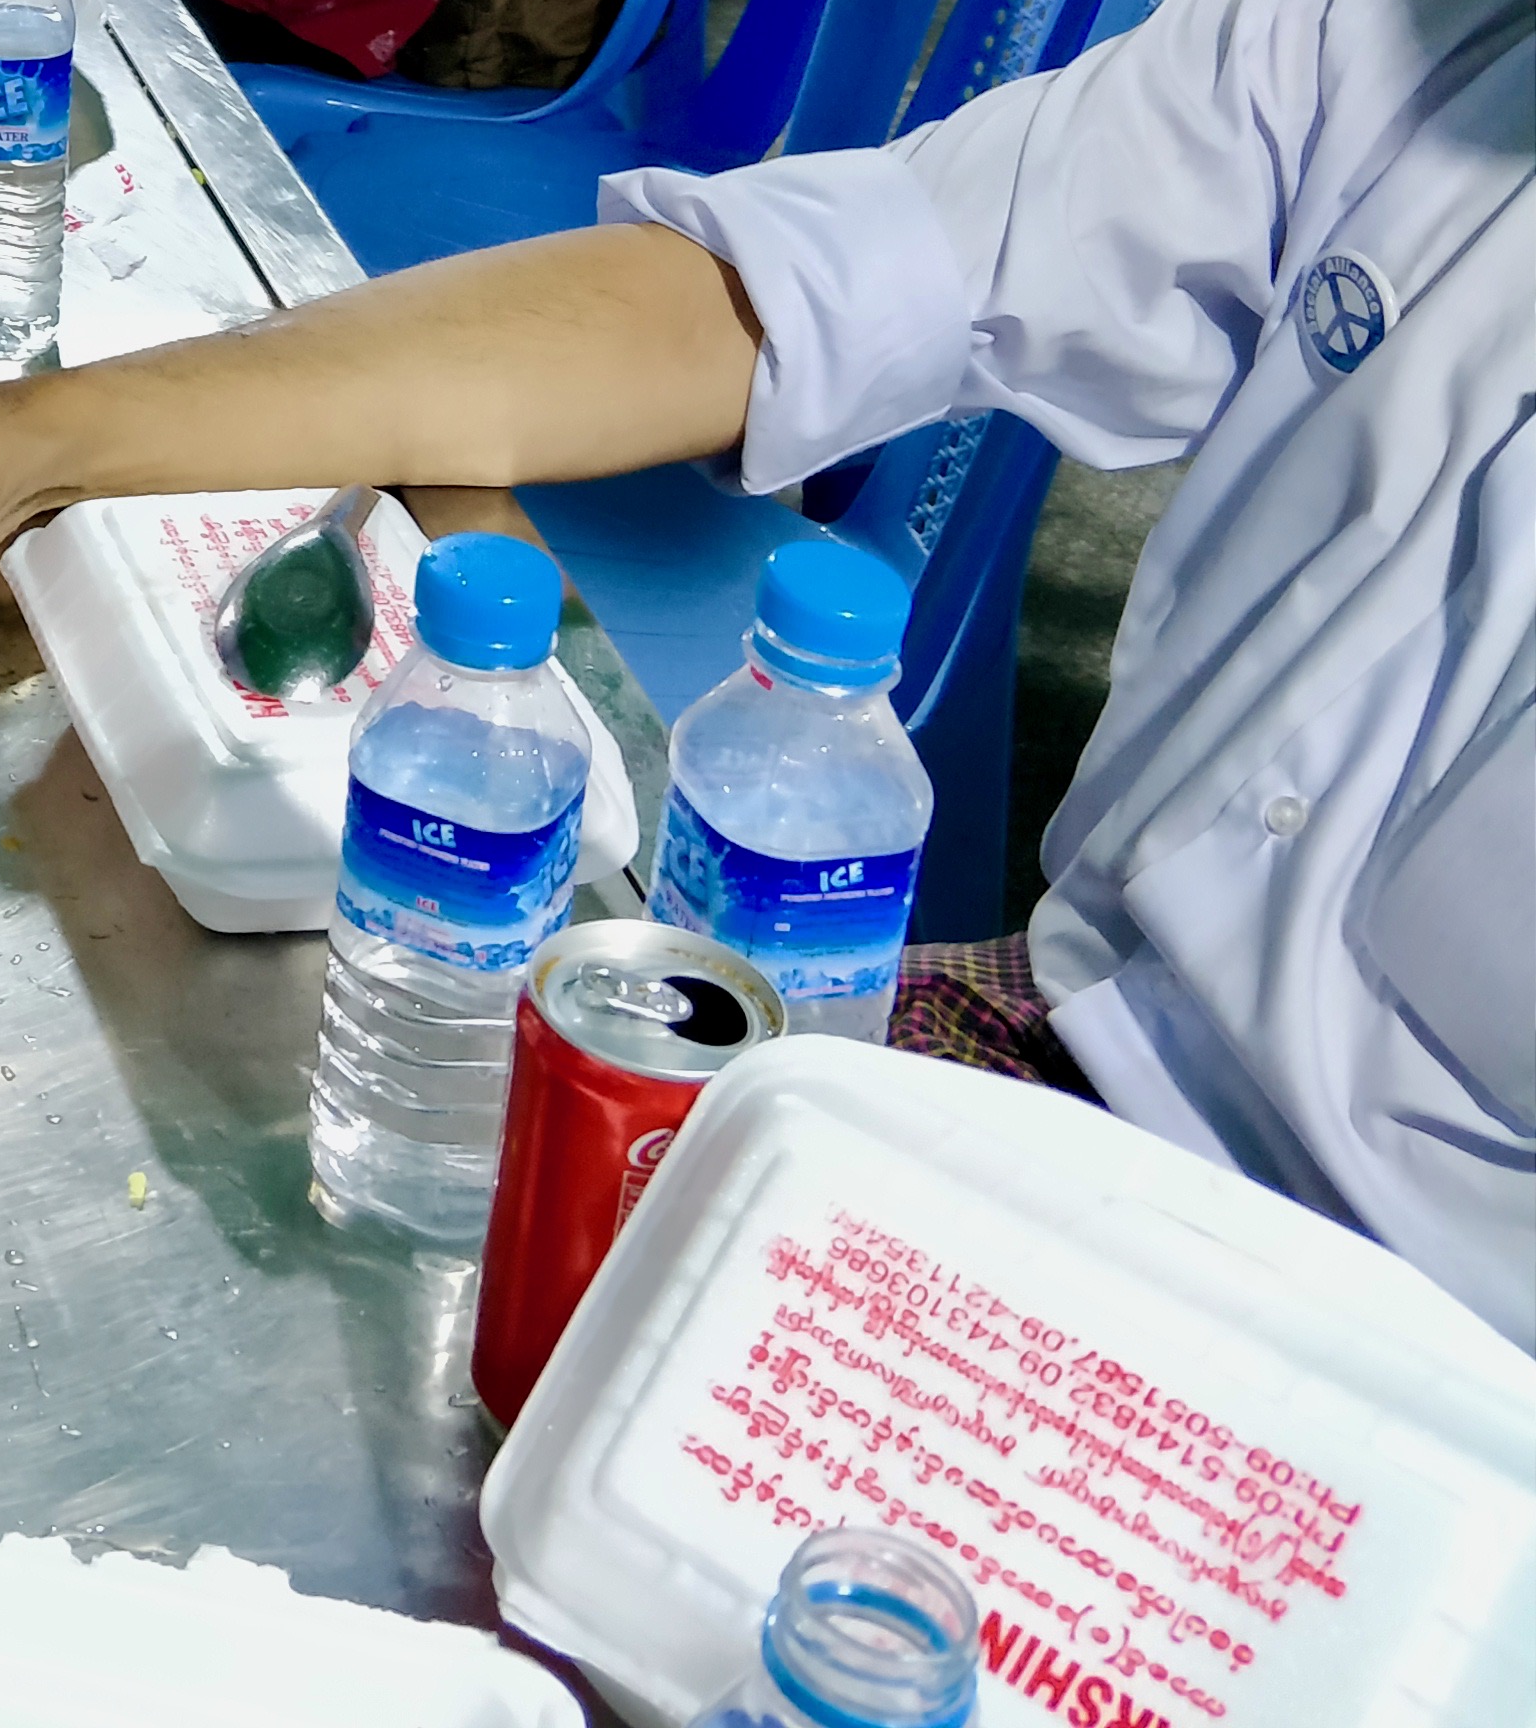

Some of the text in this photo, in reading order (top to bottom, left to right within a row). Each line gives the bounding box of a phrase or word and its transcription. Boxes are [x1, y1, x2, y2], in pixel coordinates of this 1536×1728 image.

[1324, 254, 1383, 316] Alliance
[411, 817, 458, 849] ICE
[819, 860, 865, 893] ICE
